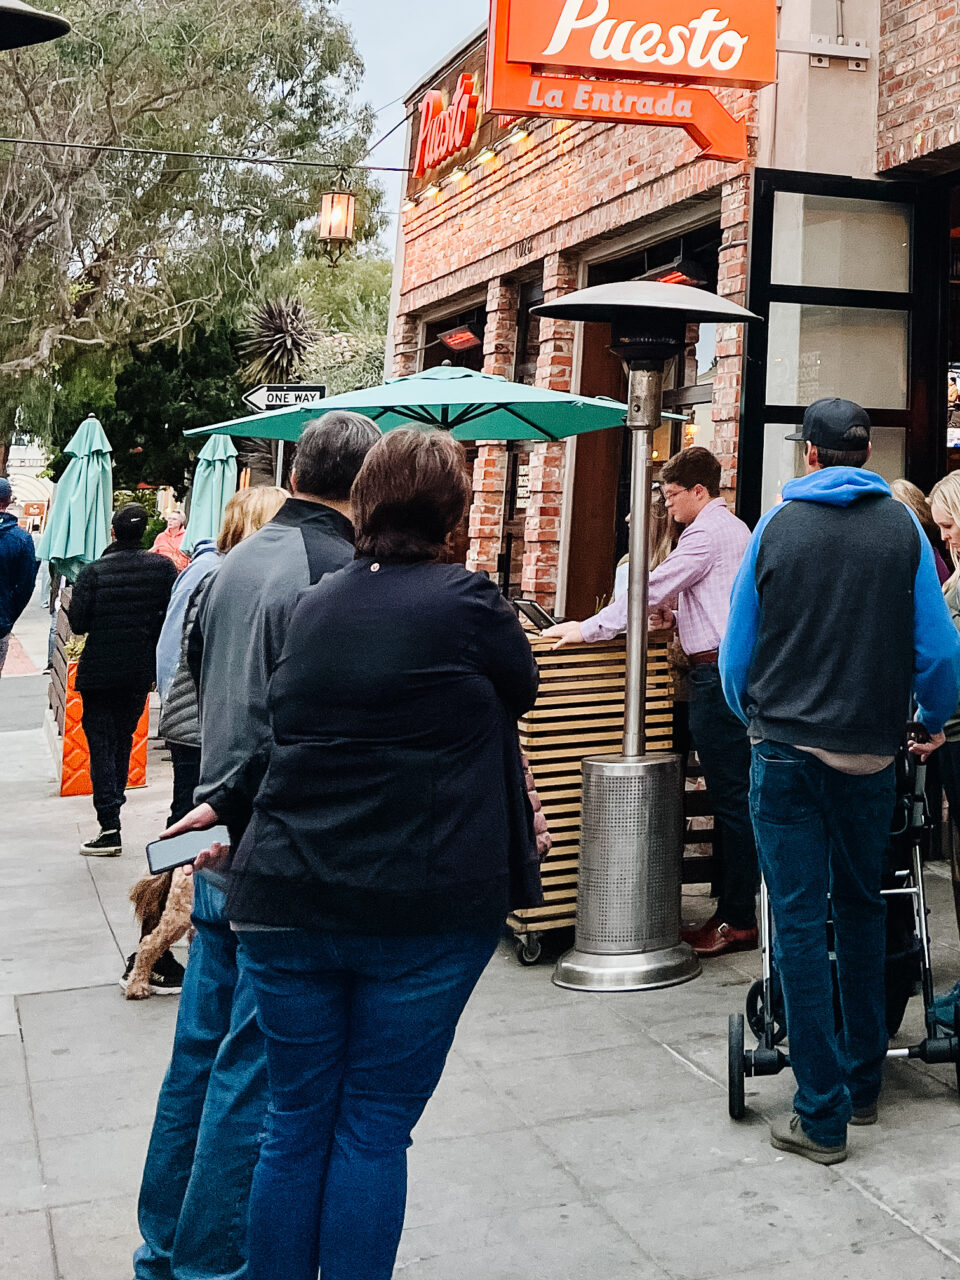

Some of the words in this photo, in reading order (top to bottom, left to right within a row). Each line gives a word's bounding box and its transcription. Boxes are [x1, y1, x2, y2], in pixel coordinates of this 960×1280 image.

[528, 80, 564, 108] La
[573, 84, 693, 117] Entrada
[412, 73, 479, 178] Puesto
[267, 393, 290, 403] ONE
[294, 393, 317, 402] WAY
